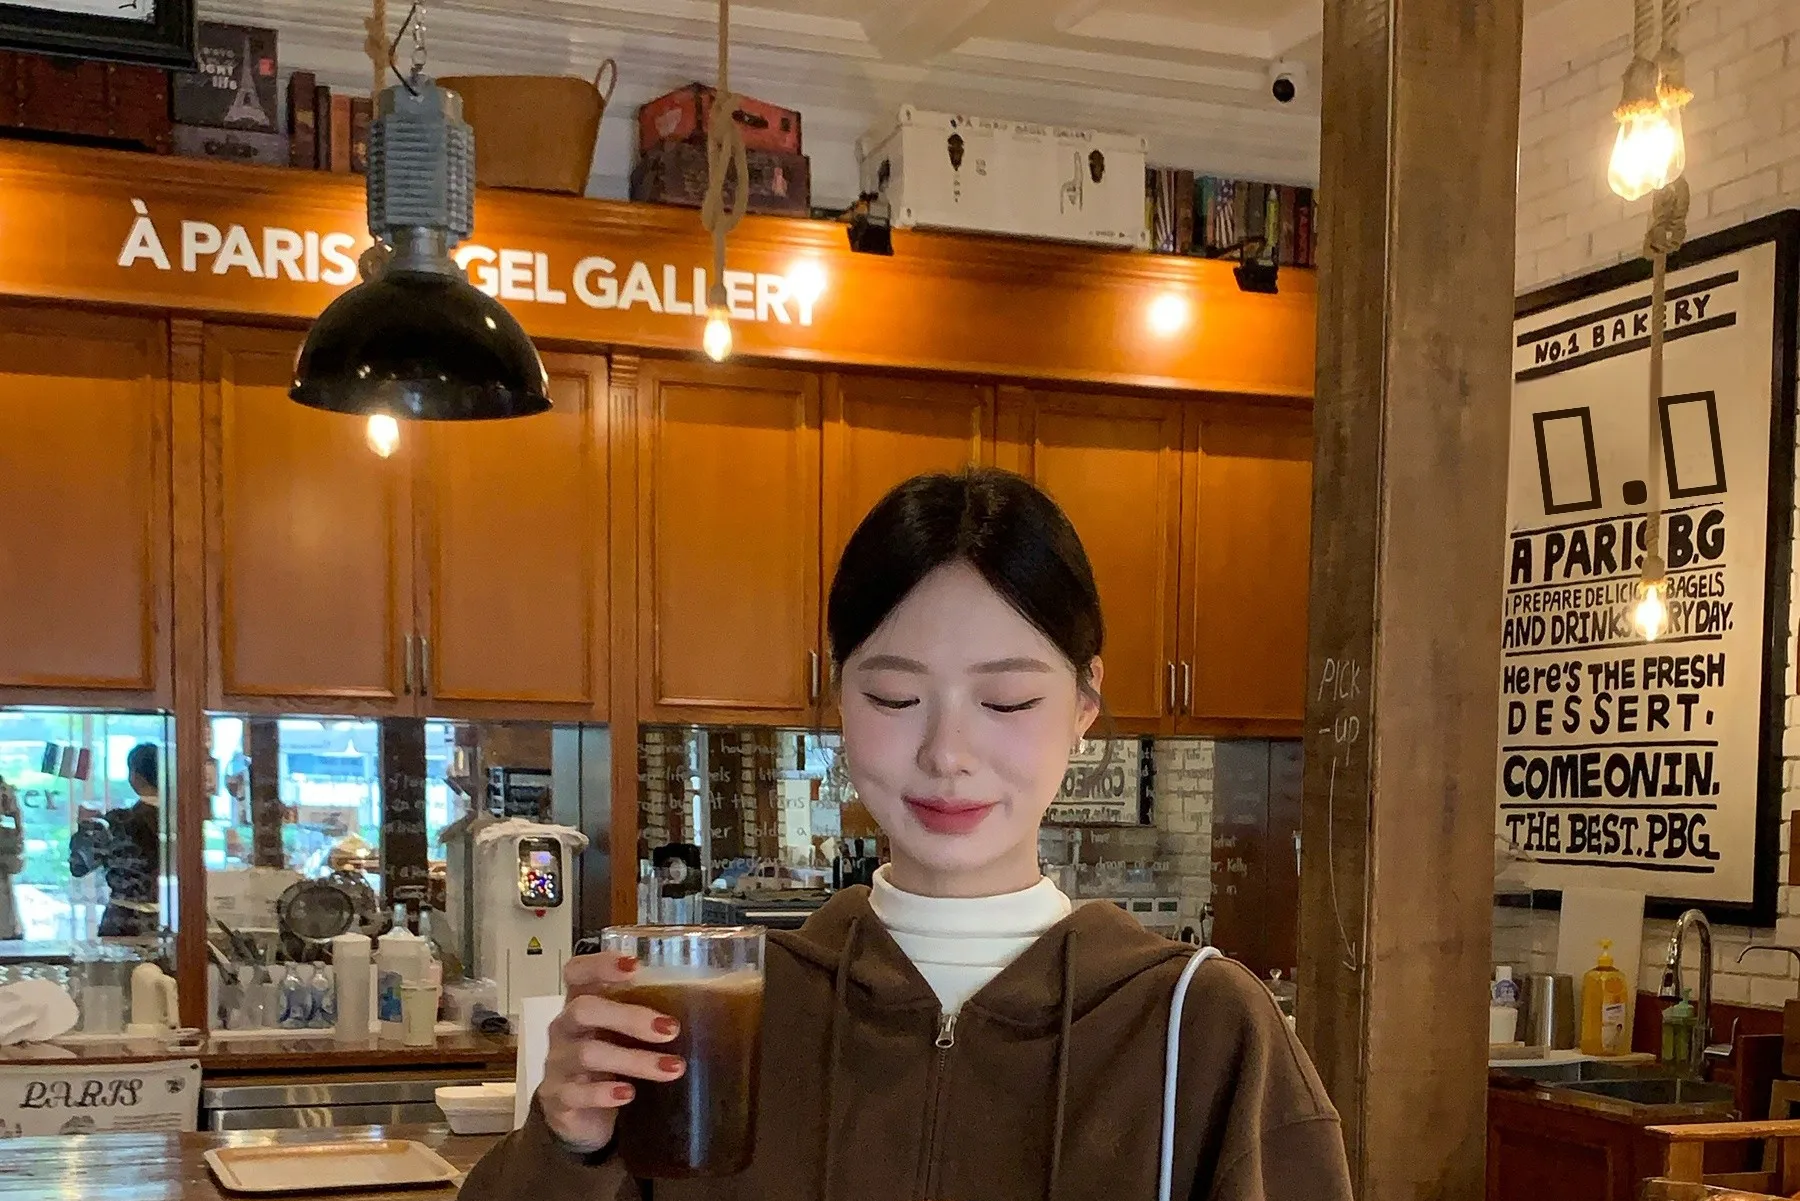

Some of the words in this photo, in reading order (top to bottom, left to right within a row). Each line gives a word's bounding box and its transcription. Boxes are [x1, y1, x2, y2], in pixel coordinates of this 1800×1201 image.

[118, 198, 172, 271] À
[180, 209, 358, 286] PARIS
[455, 244, 566, 305] GEL
[573, 256, 824, 326] GALLERY
[1534, 332, 1580, 365] NO.1
[1592, 294, 1711, 348] BAKRY
[1510, 538, 1532, 585] A
[1513, 588, 1582, 613] PREPARE
[1666, 571, 1726, 599] BAGELS
[1503, 614, 1546, 649] AND
[1318, 656, 1361, 701] PICK
[1588, 658, 1636, 694] THE
[1643, 652, 1726, 690] FRESH
[1506, 811, 1561, 853] THE
[19, 1078, 143, 1109] PARIS
